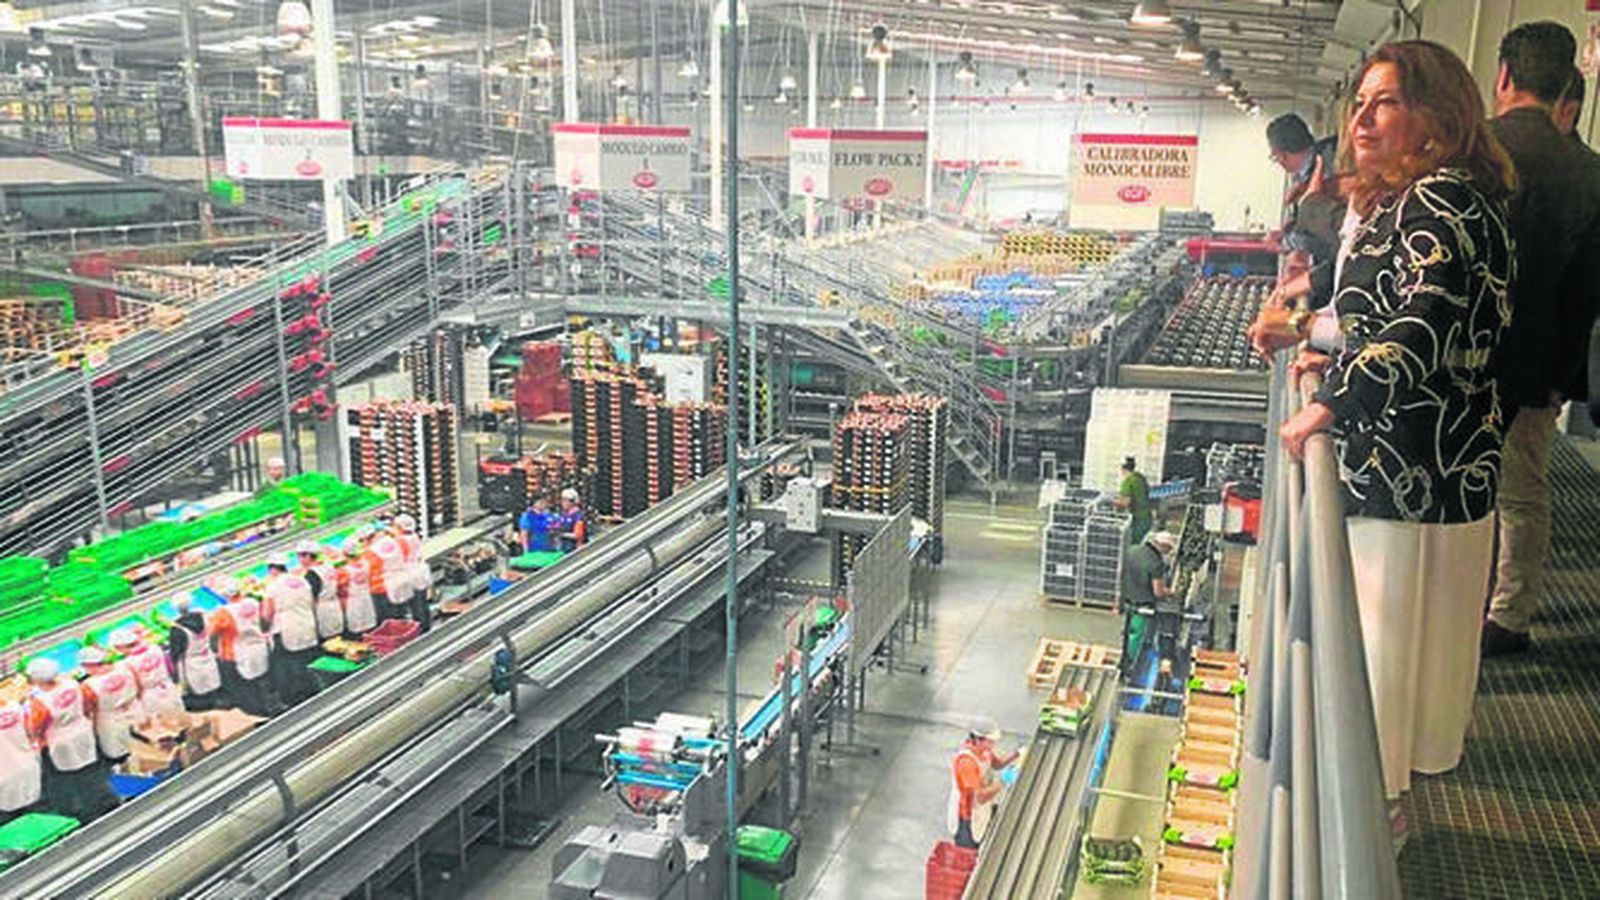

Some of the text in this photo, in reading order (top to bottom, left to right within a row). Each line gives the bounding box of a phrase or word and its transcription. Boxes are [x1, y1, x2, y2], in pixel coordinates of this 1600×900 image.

[834, 152, 873, 166] FLOW
[878, 153, 914, 166] PACK
[916, 154, 923, 166] 2
[1087, 146, 1189, 162] CALIBRADORA
[1083, 163, 1191, 179] MONOCALIBRE
